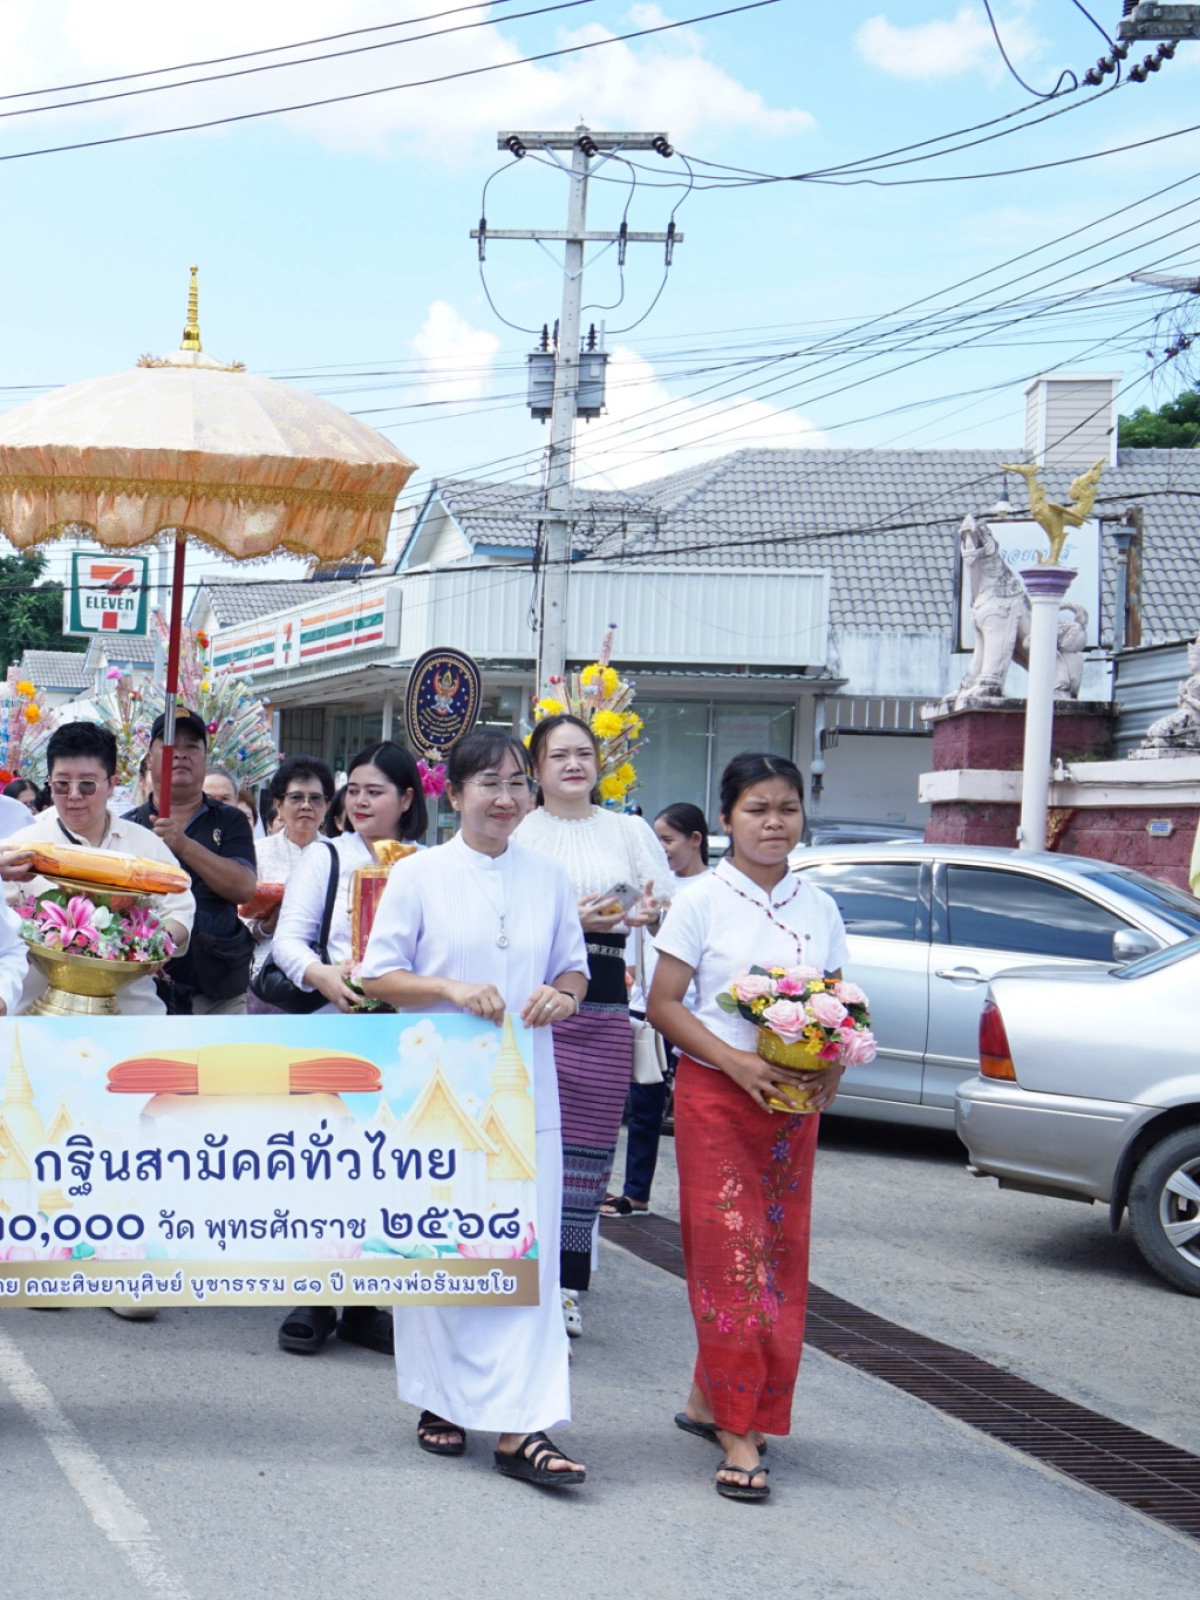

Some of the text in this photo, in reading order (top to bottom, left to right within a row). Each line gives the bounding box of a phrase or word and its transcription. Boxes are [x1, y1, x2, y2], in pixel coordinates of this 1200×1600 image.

[34, 1118, 456, 1197] กฐินสามัคคีทั่วไทย
[158, 1209, 194, 1240] วัด
[204, 1208, 366, 1251] พุทธศักราช
[380, 1206, 521, 1240] ๒๕๖๘
[26, 1272, 182, 1299] คณะศิษยานุศิษย์
[191, 1277, 285, 1299] บูชาธรรม
[293, 1279, 322, 1293] ๘๑
[330, 1272, 343, 1292] ปี
[353, 1270, 514, 1293] หลวงพ่อธัมมชโย
